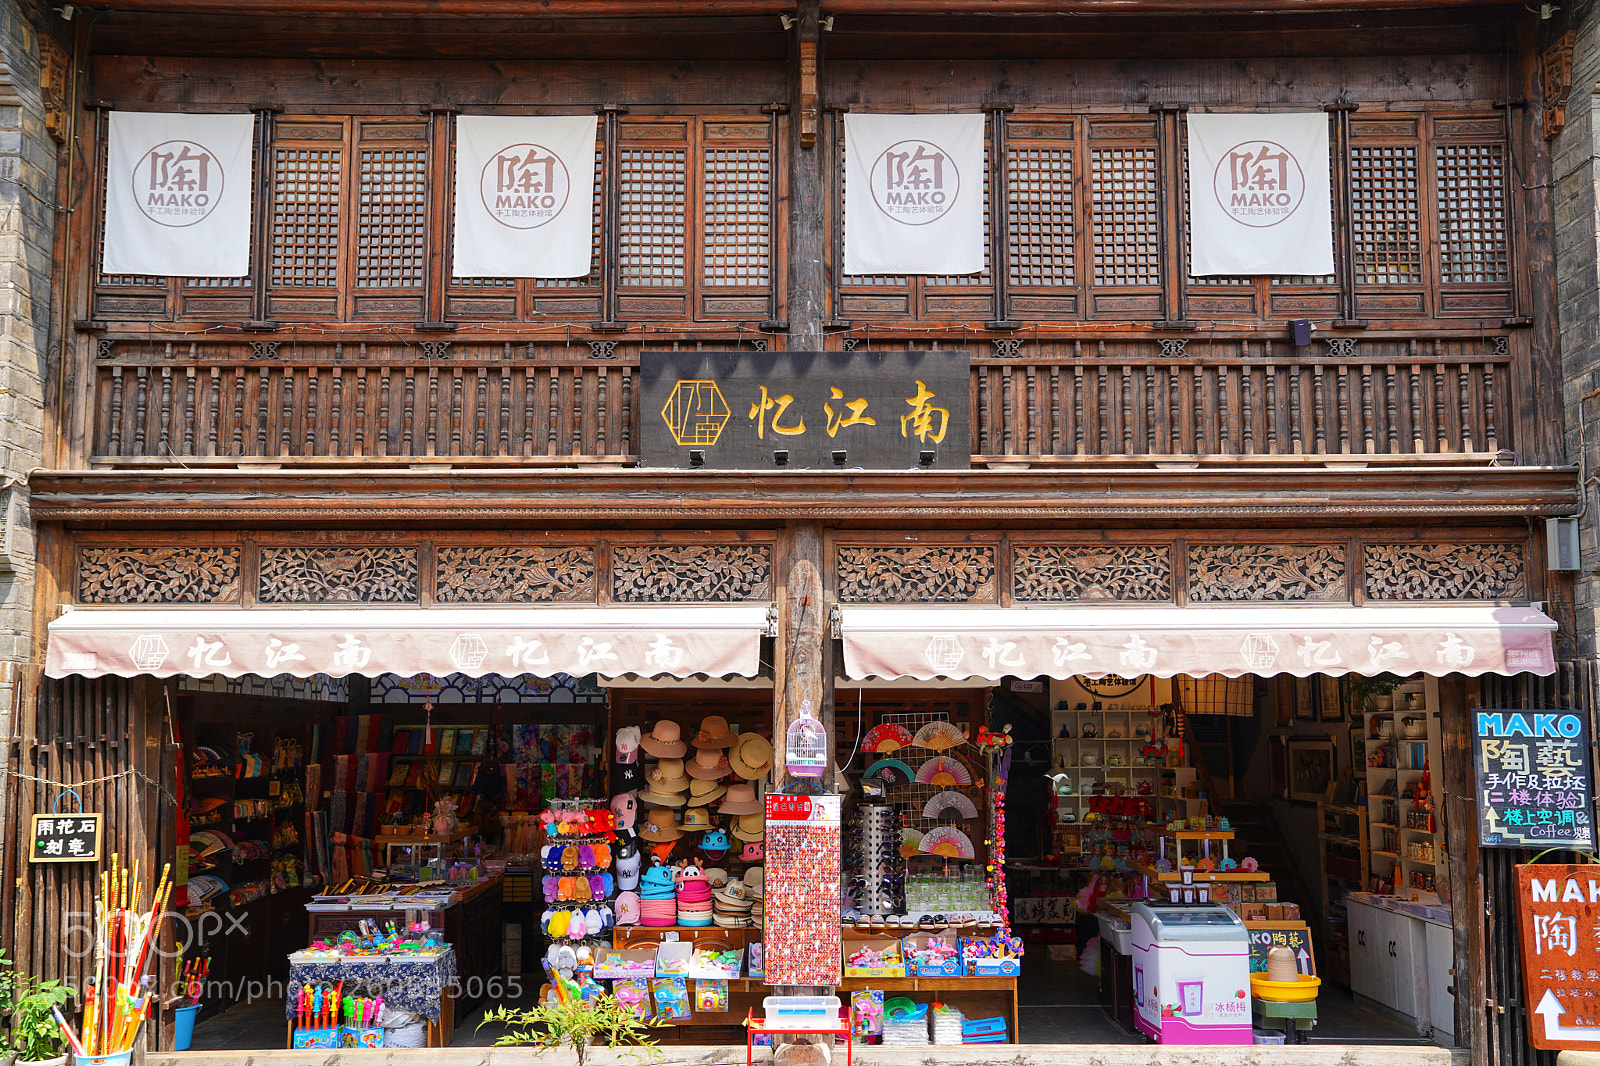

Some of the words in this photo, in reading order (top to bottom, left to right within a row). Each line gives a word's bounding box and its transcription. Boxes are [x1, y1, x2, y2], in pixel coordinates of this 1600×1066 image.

[150, 146, 210, 191] 陶
[497, 149, 556, 193] 陶
[887, 145, 945, 190] 陶
[1230, 146, 1289, 190] 陶
[147, 193, 209, 207] MAKO
[495, 195, 556, 209] MAKO
[886, 191, 946, 205] MAKO
[1231, 193, 1291, 206] MAKO
[148, 207, 206, 215] 手工陶艺体验馆
[496, 209, 553, 217] 手工陶艺体验馆
[887, 205, 944, 214] 手工陶艺体验馆
[1231, 207, 1289, 216] 手工陶艺体验馆
[748, 380, 950, 444] 忆江南
[188, 634, 372, 668] 忆江南
[506, 633, 683, 667] 忆江南
[981, 634, 1159, 669] 忆江南
[1297, 632, 1476, 667] 忆江南
[1477, 712, 1582, 738] MAKO
[1486, 772, 1586, 791] 手作及拉坯
[37, 819, 95, 836] 雨花石
[1530, 824, 1571, 837] Coffee
[43, 838, 94, 857] 刻章
[1534, 911, 1600, 957] 陶
[1215, 1002, 1246, 1013] 冰杨梅
